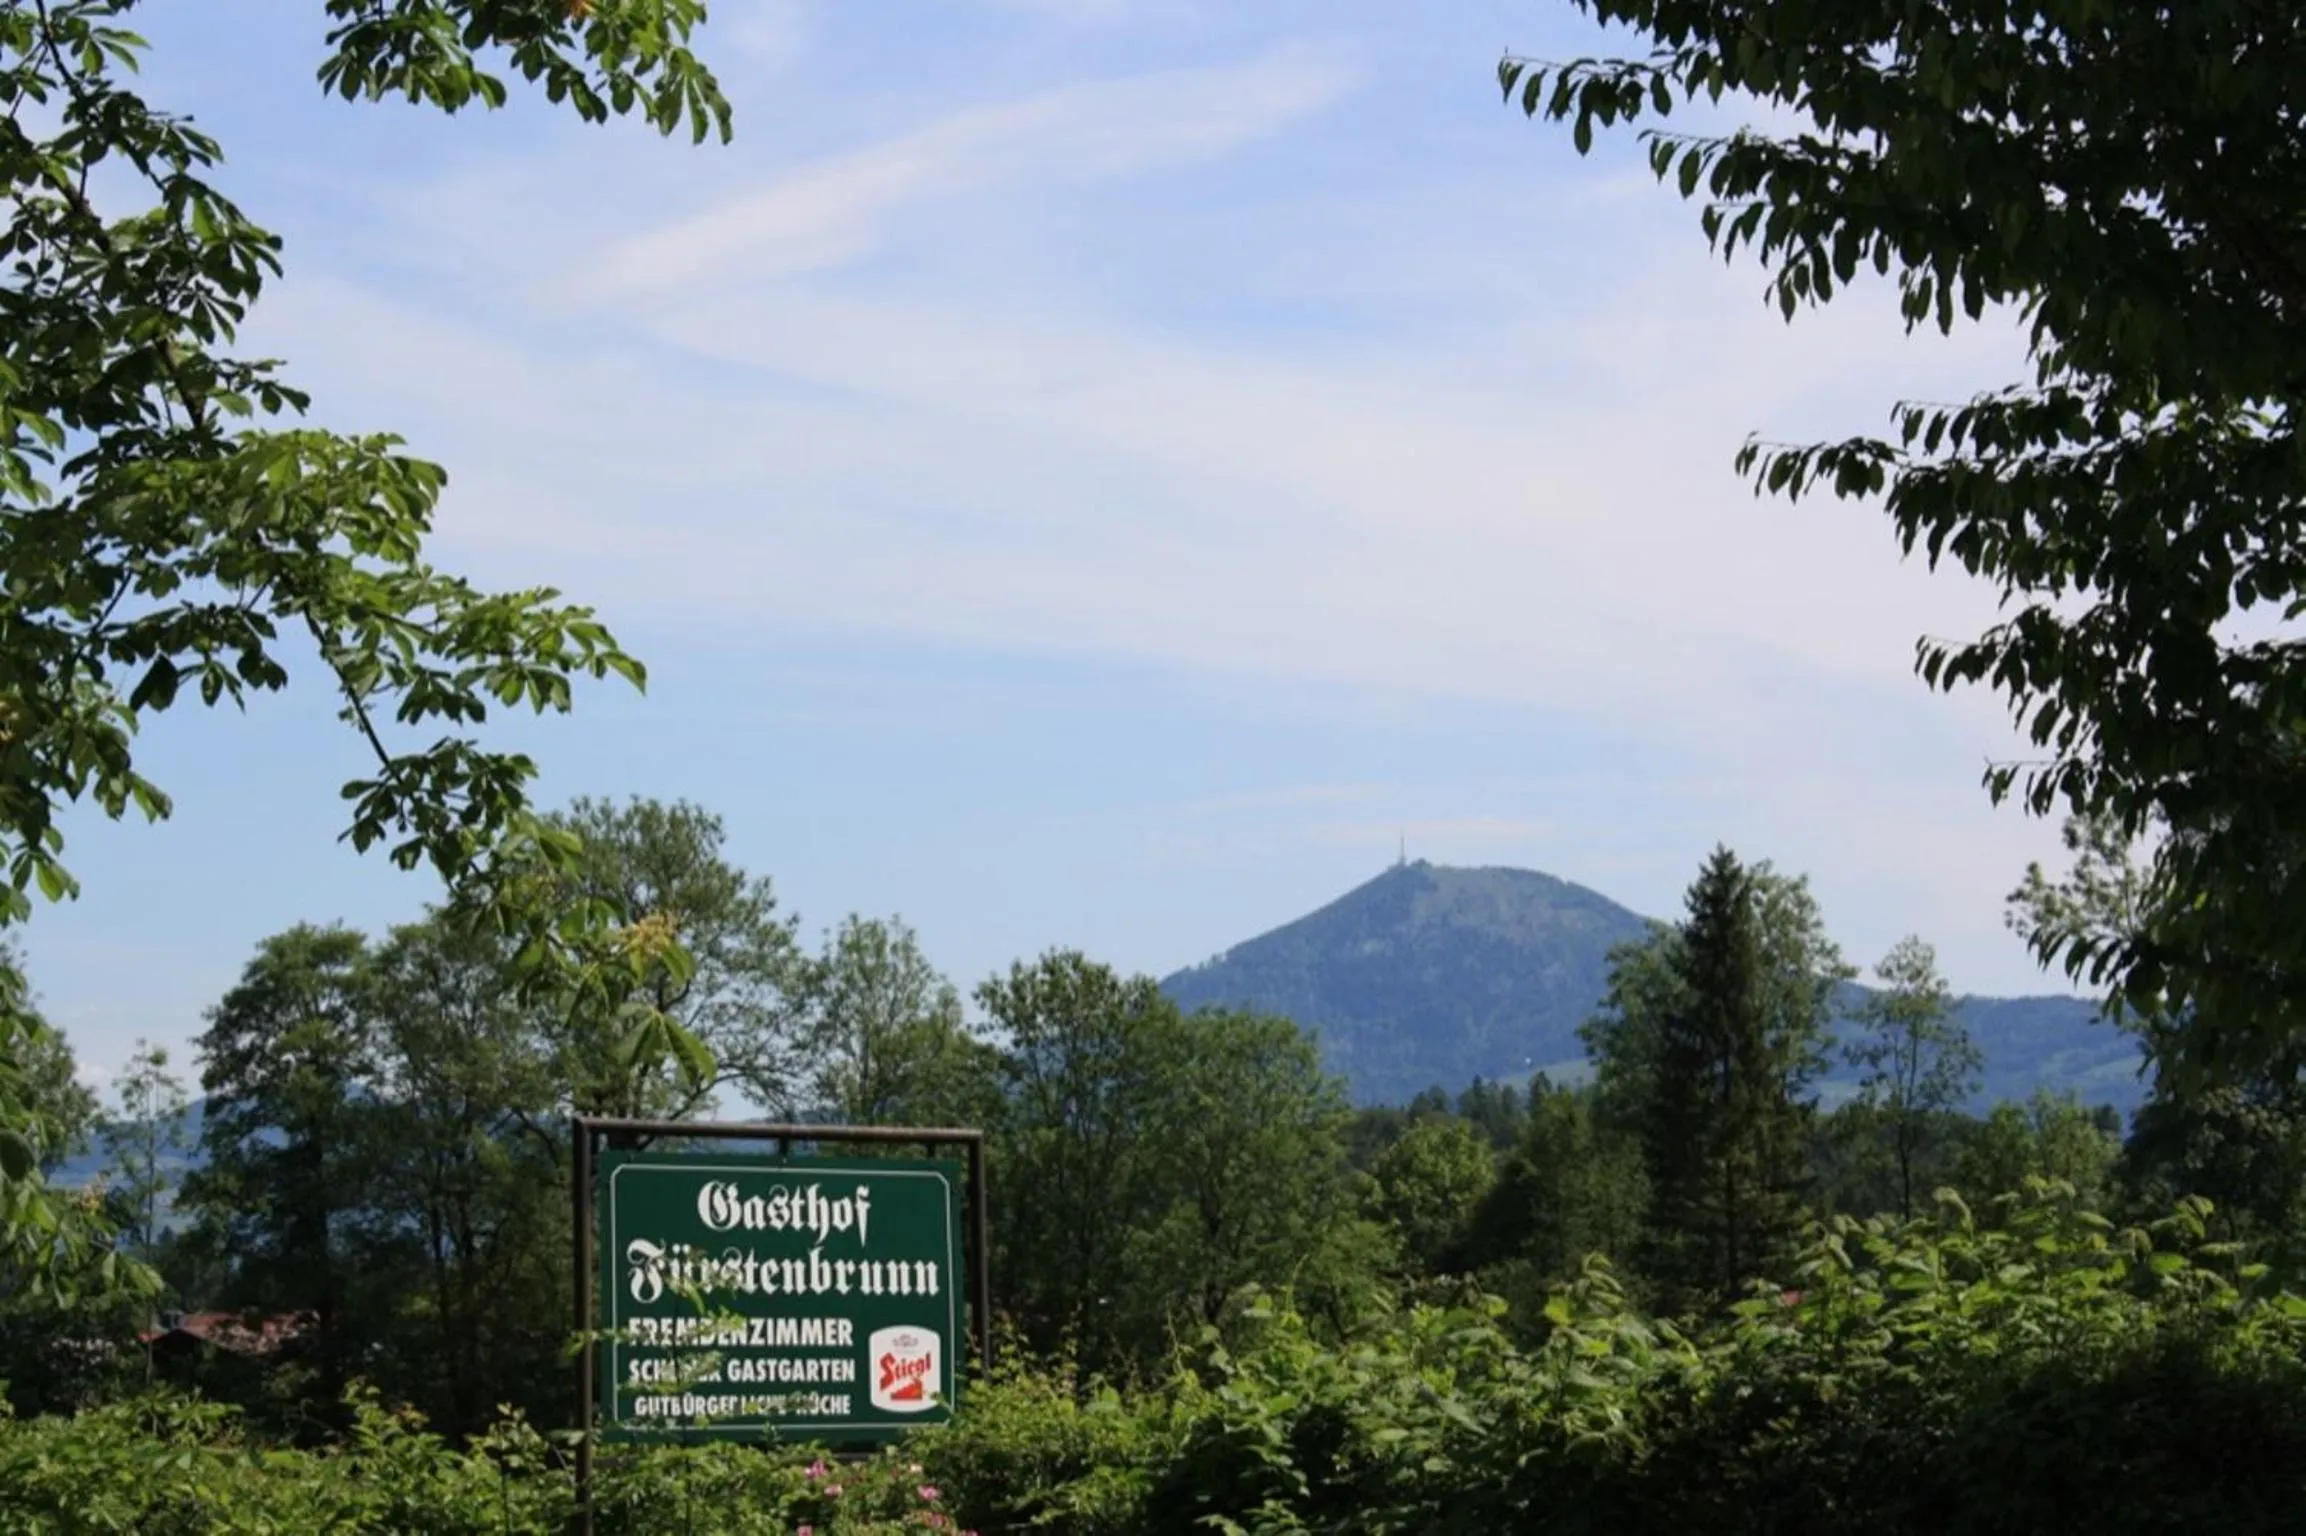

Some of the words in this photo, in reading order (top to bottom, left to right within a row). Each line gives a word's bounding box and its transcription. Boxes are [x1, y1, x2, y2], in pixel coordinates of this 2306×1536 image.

[697, 1180, 871, 1248] Gasthof
[627, 1238, 939, 1304] Fürstenbrunn
[727, 1357, 856, 1383] GASTGARTEN
